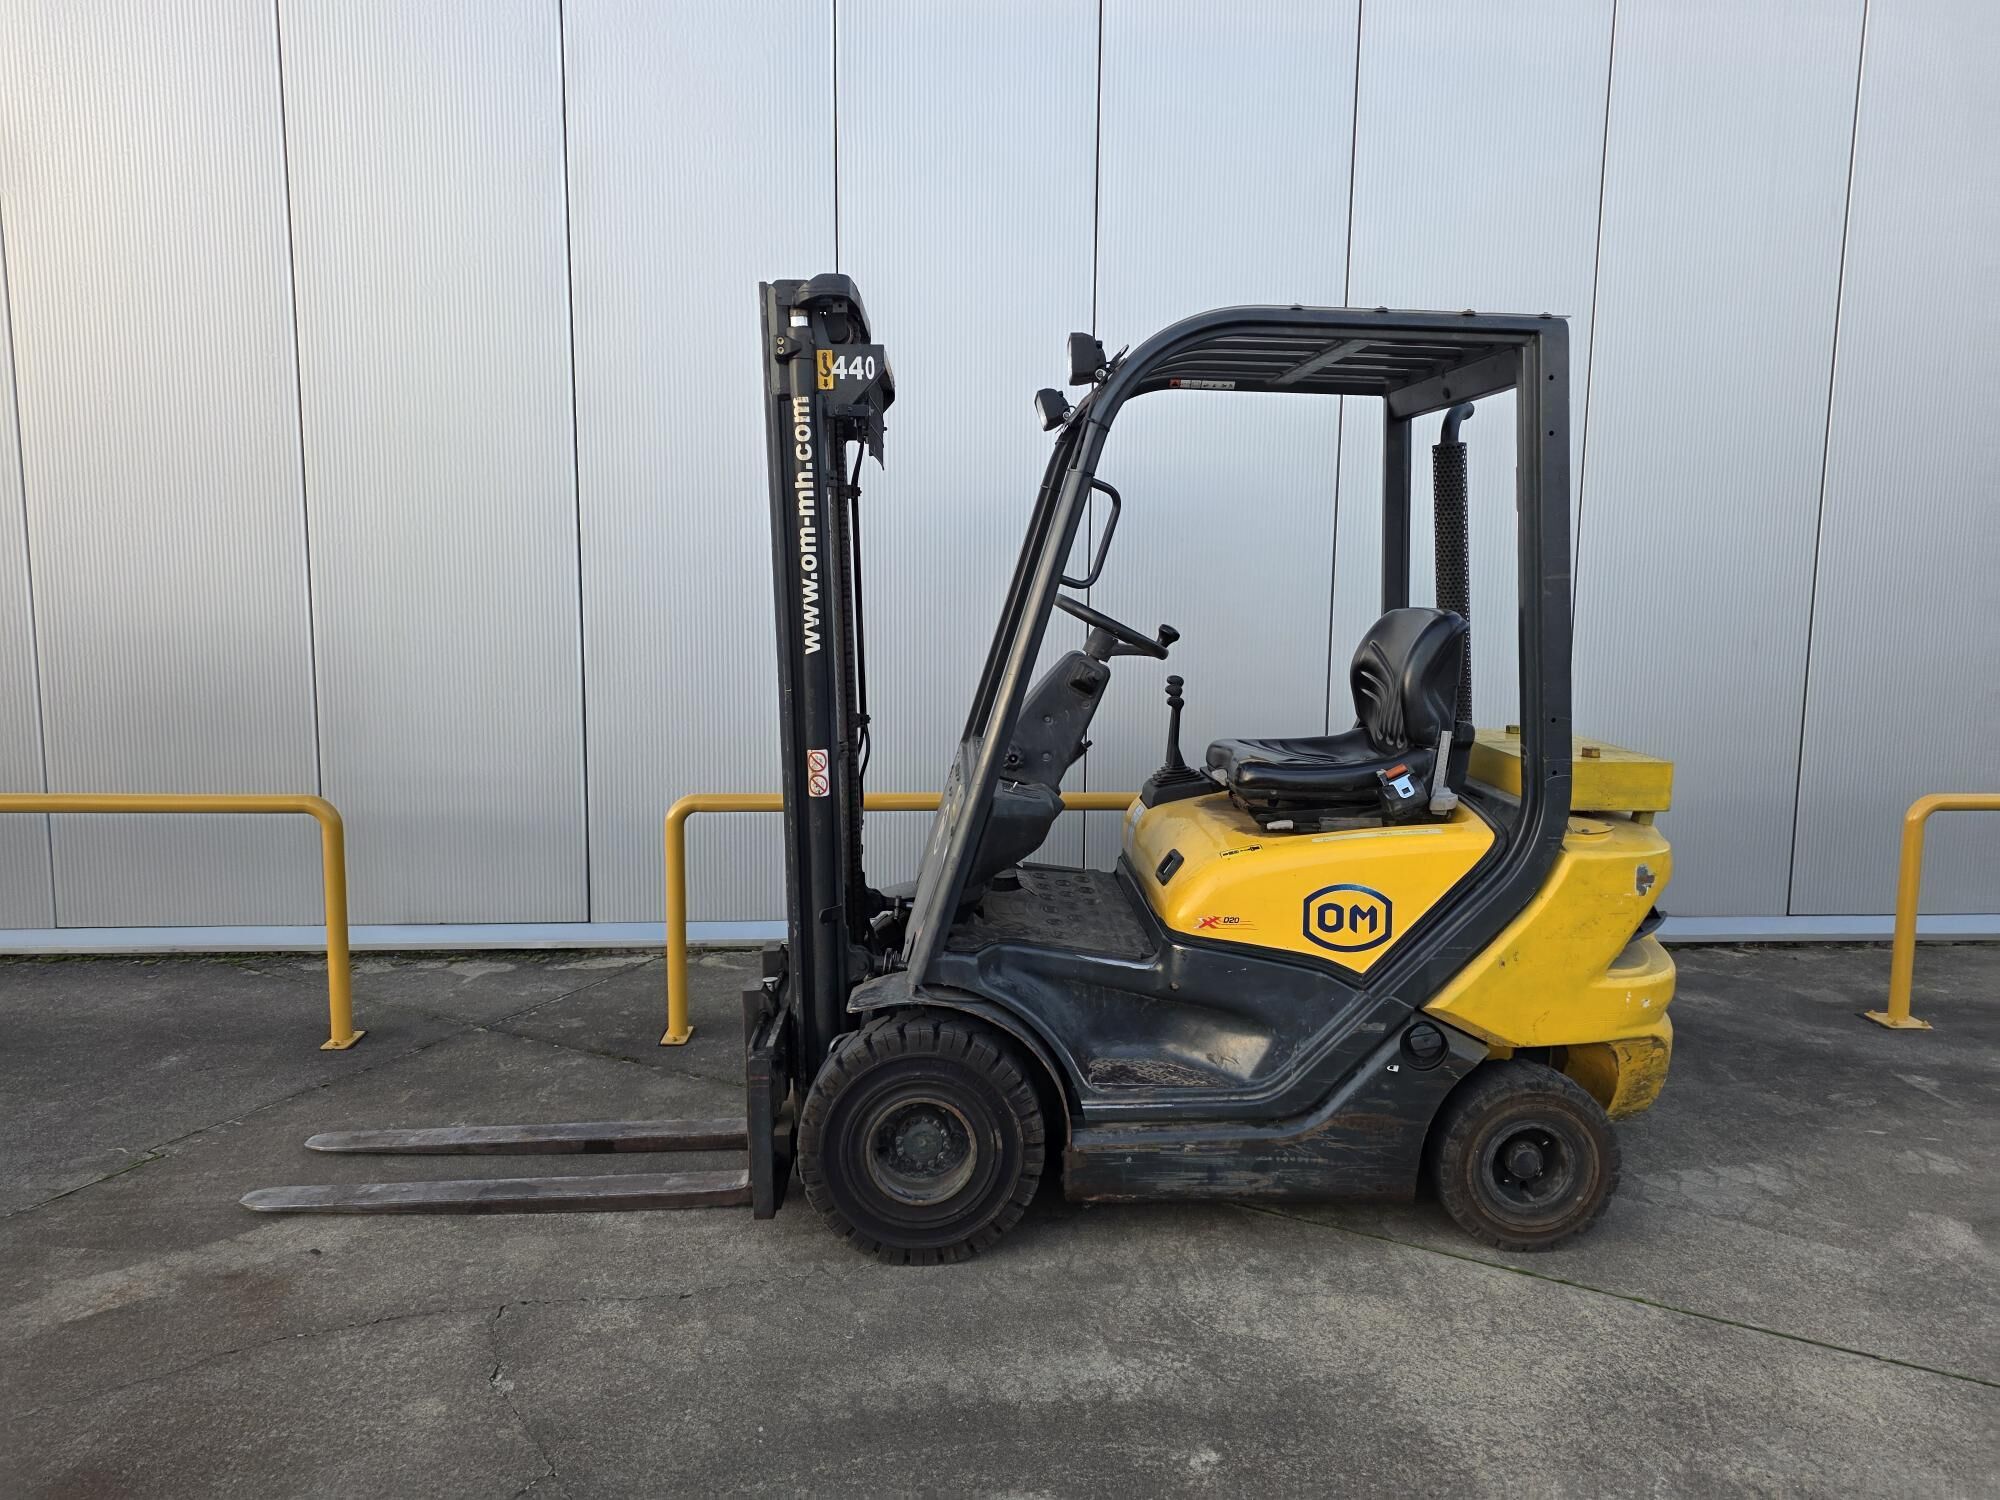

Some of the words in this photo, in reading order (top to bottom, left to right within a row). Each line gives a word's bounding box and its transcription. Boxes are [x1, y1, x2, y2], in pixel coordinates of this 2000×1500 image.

[832, 356, 875, 380] 440
[793, 396, 820, 654] www.om-mh.com
[1317, 902, 1377, 933] OM
